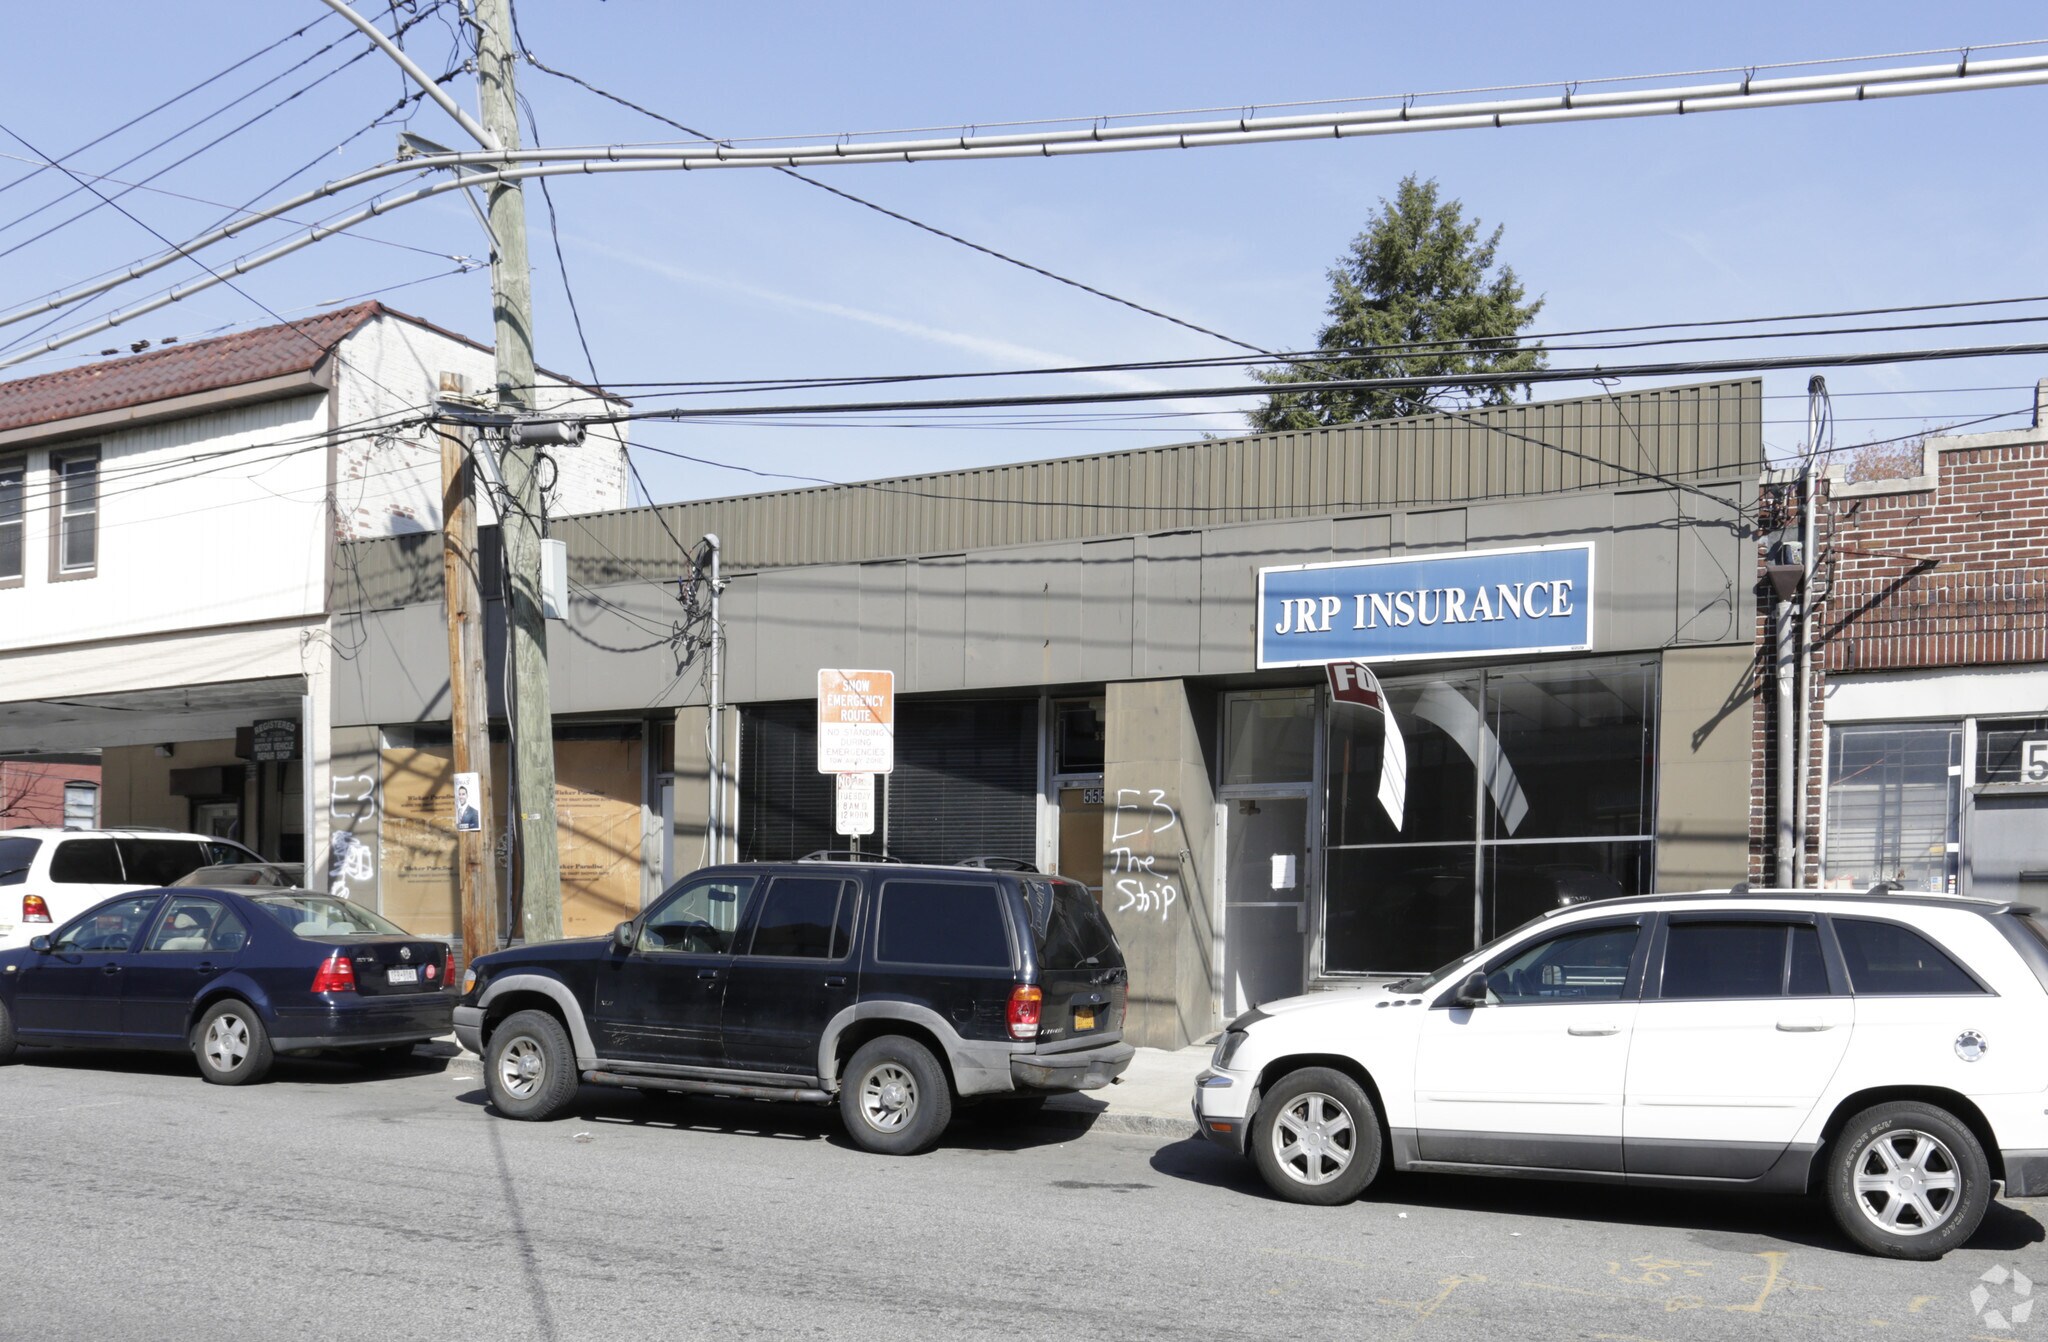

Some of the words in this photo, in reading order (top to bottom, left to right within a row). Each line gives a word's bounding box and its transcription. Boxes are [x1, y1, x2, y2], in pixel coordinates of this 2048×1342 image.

[1275, 596, 1342, 634] JRP
[1353, 579, 1574, 630] INSURANCE
[842, 679, 870, 692] SNOW
[1333, 664, 1381, 698] FO
[827, 694, 885, 708] EMERGENCY
[840, 709, 872, 722] ROUTE
[254, 720, 296, 736] REGISTERED
[827, 728, 840, 737] NO
[843, 728, 885, 737] STANDING
[273, 741, 295, 750] VEHICLE
[840, 738, 872, 746] DURING
[2027, 744, 2048, 781] 5
[840, 792, 871, 800] TUESDAY
[1112, 789, 1176, 843] E3
[1110, 847, 1169, 880] The
